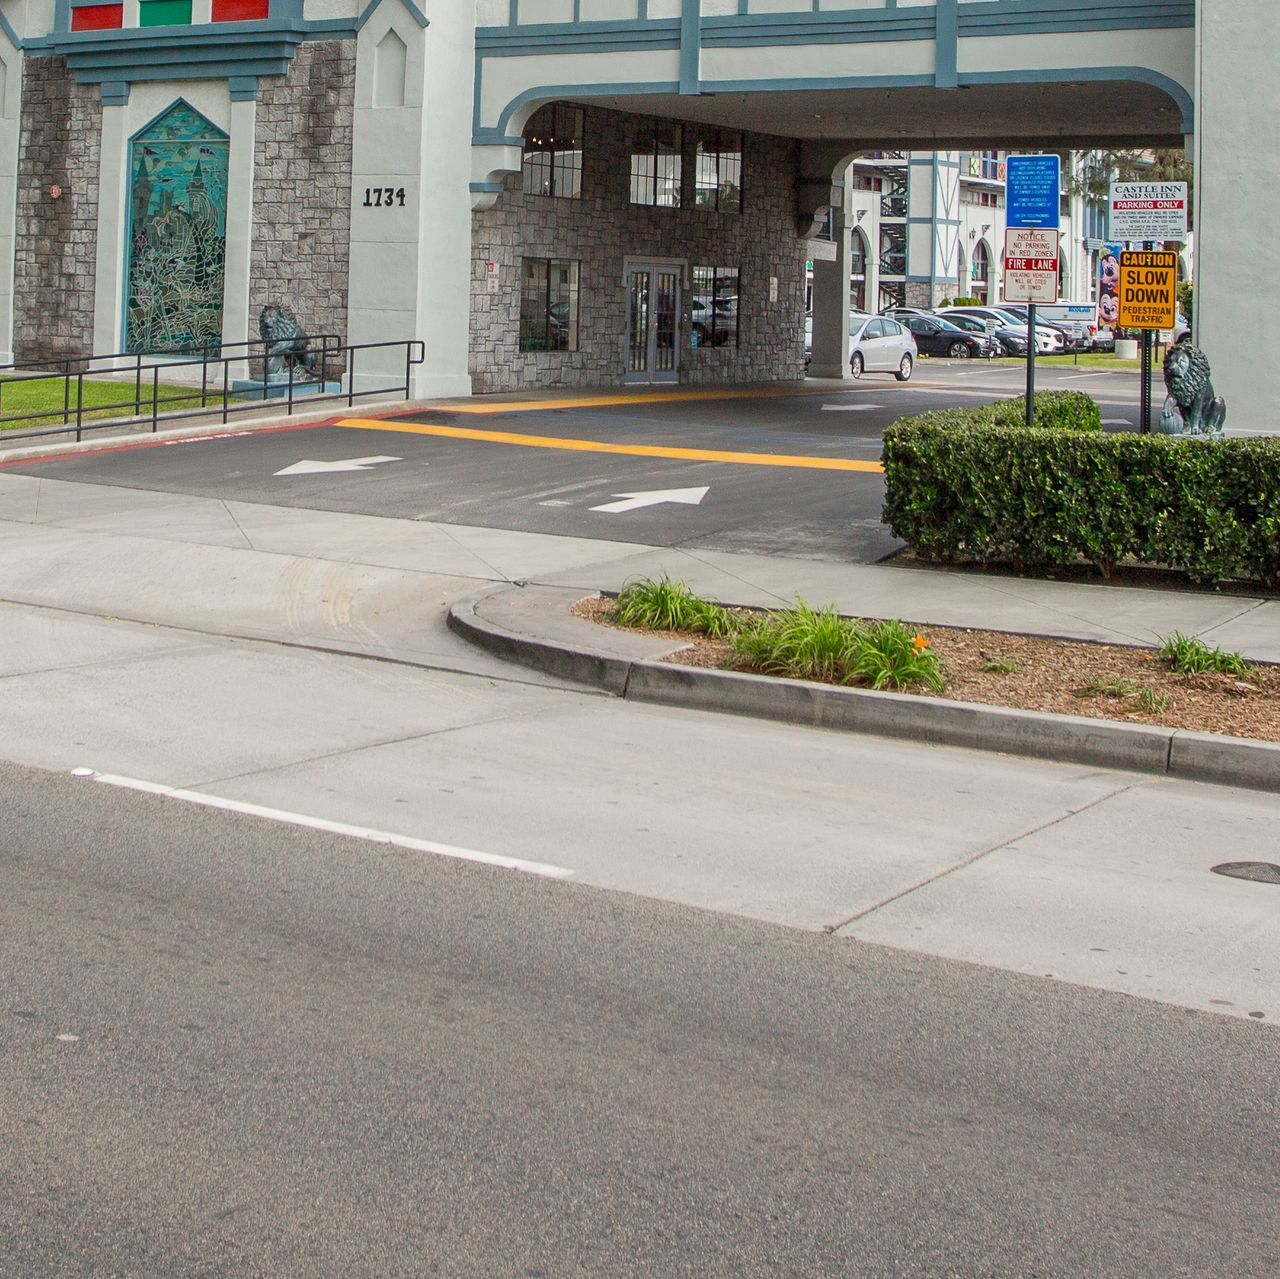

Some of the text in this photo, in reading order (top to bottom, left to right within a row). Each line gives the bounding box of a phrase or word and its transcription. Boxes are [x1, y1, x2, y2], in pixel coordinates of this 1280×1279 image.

[363, 188, 405, 206] 1734
[1008, 259, 1054, 270] FIRE LANE
[1123, 254, 1173, 266] CAUTION
[1127, 270, 1168, 285] SLOW
[1125, 288, 1169, 303] DOWN
[1123, 306, 1171, 315] PEDESTRIAN
